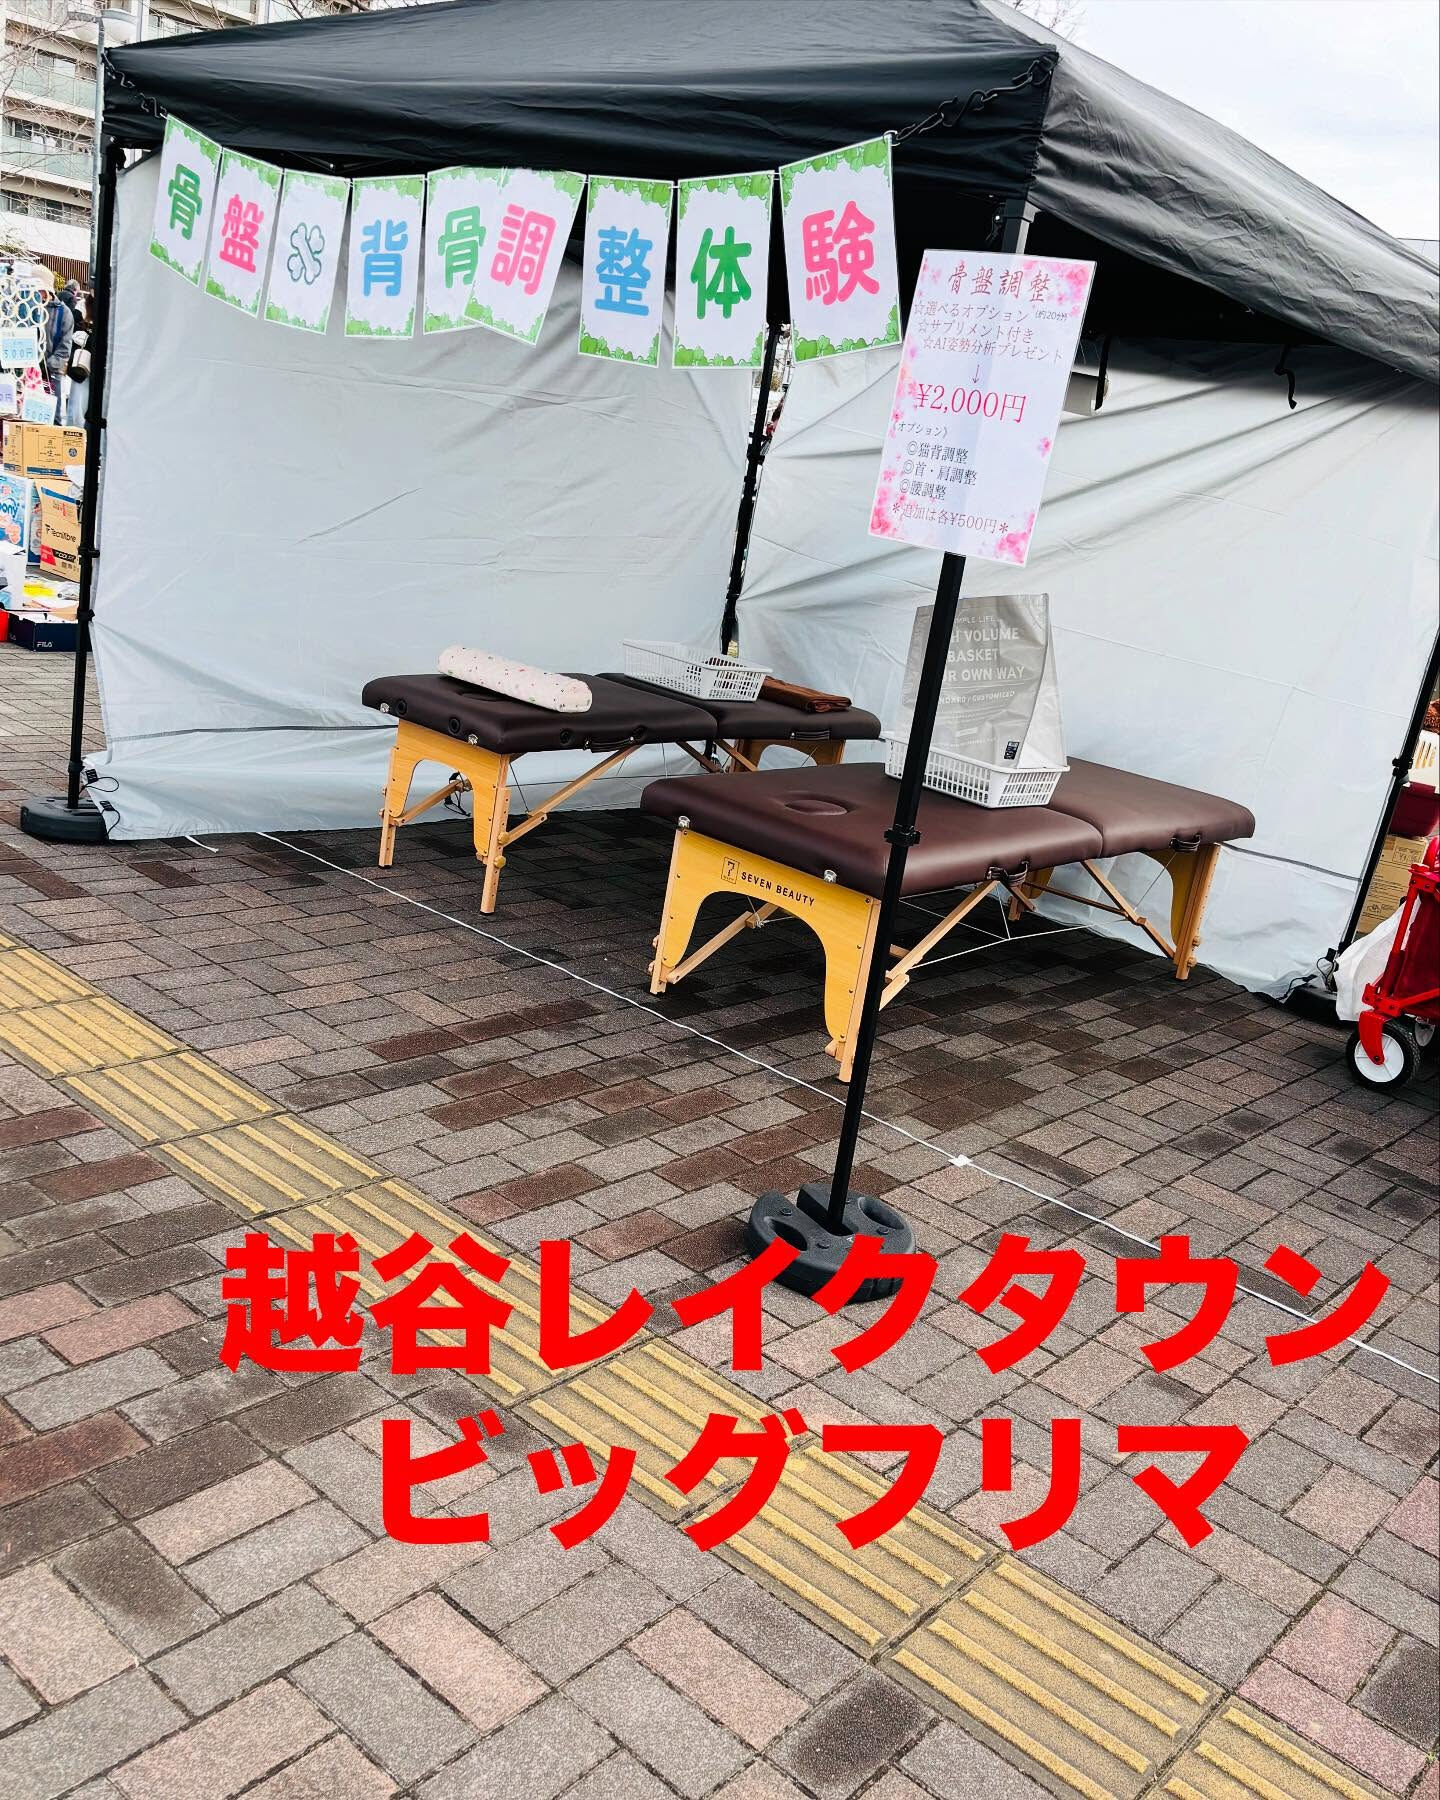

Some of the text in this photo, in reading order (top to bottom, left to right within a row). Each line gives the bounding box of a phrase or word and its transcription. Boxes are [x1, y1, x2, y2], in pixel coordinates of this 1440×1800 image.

[948, 263, 1051, 303] 骨盤調整
[917, 383, 1027, 424] ¥2,000円
[965, 627, 1019, 642] VOLUME
[947, 648, 999, 663] BASKET
[961, 668, 992, 682] OWN
[996, 666, 1025, 680] WAY
[741, 871, 772, 890] SEVEN
[775, 884, 815, 907] BEAUTY
